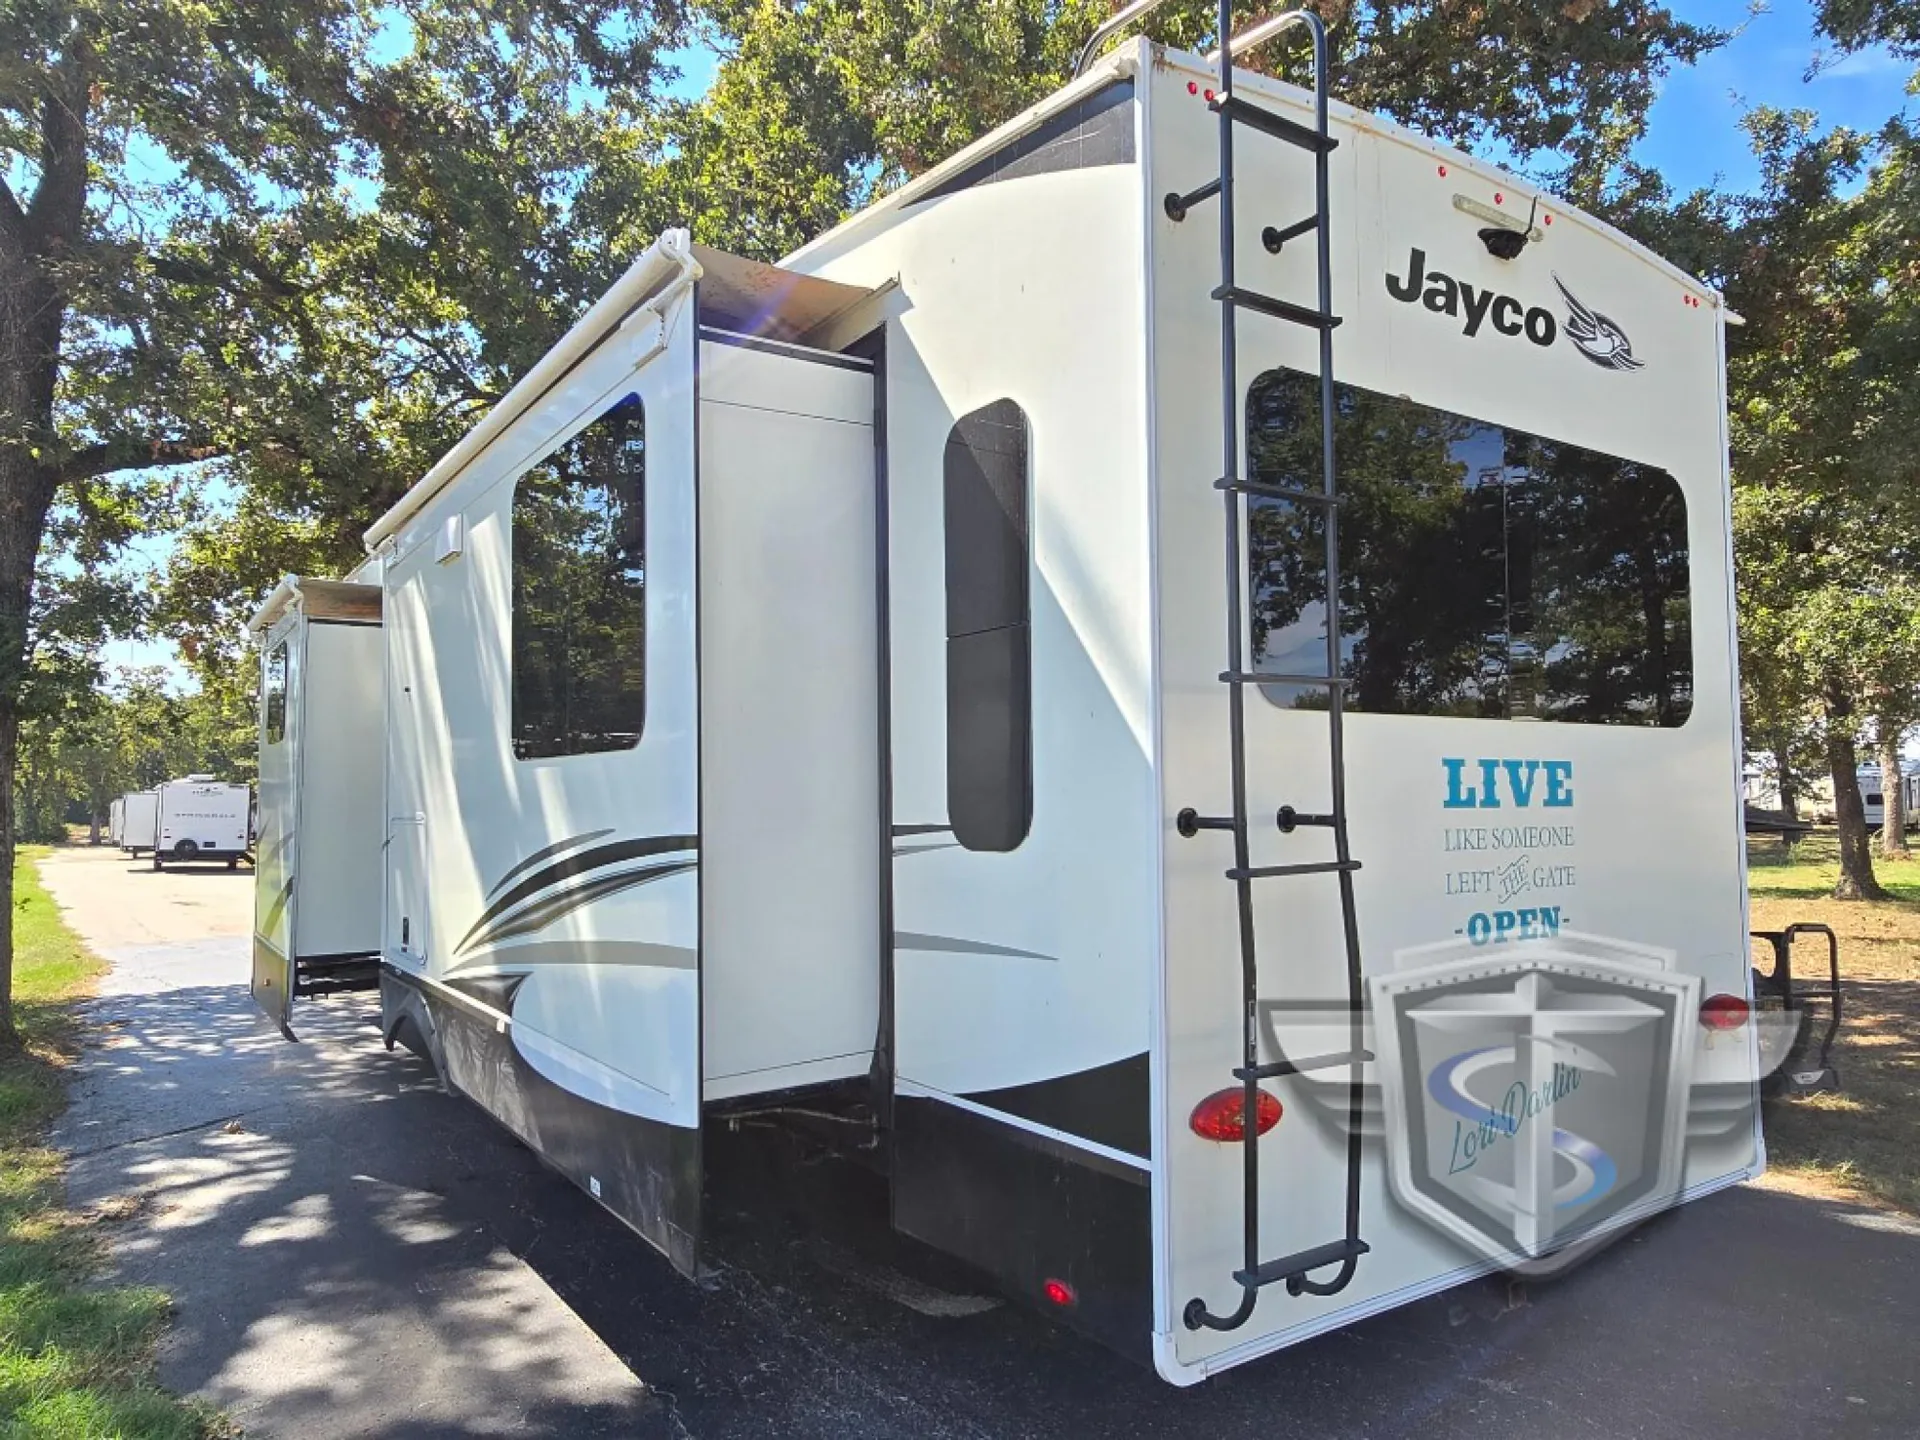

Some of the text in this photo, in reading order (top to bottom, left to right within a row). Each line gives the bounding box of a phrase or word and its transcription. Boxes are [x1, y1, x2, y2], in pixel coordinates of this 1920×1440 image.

[1385, 247, 1557, 347] Jayco
[1441, 758, 1574, 809] LIVE
[1444, 826, 1574, 851] LIKE SOMEONE
[1446, 864, 1576, 895] LEFT THE GATE
[1449, 1106, 1499, 1176] Lori
